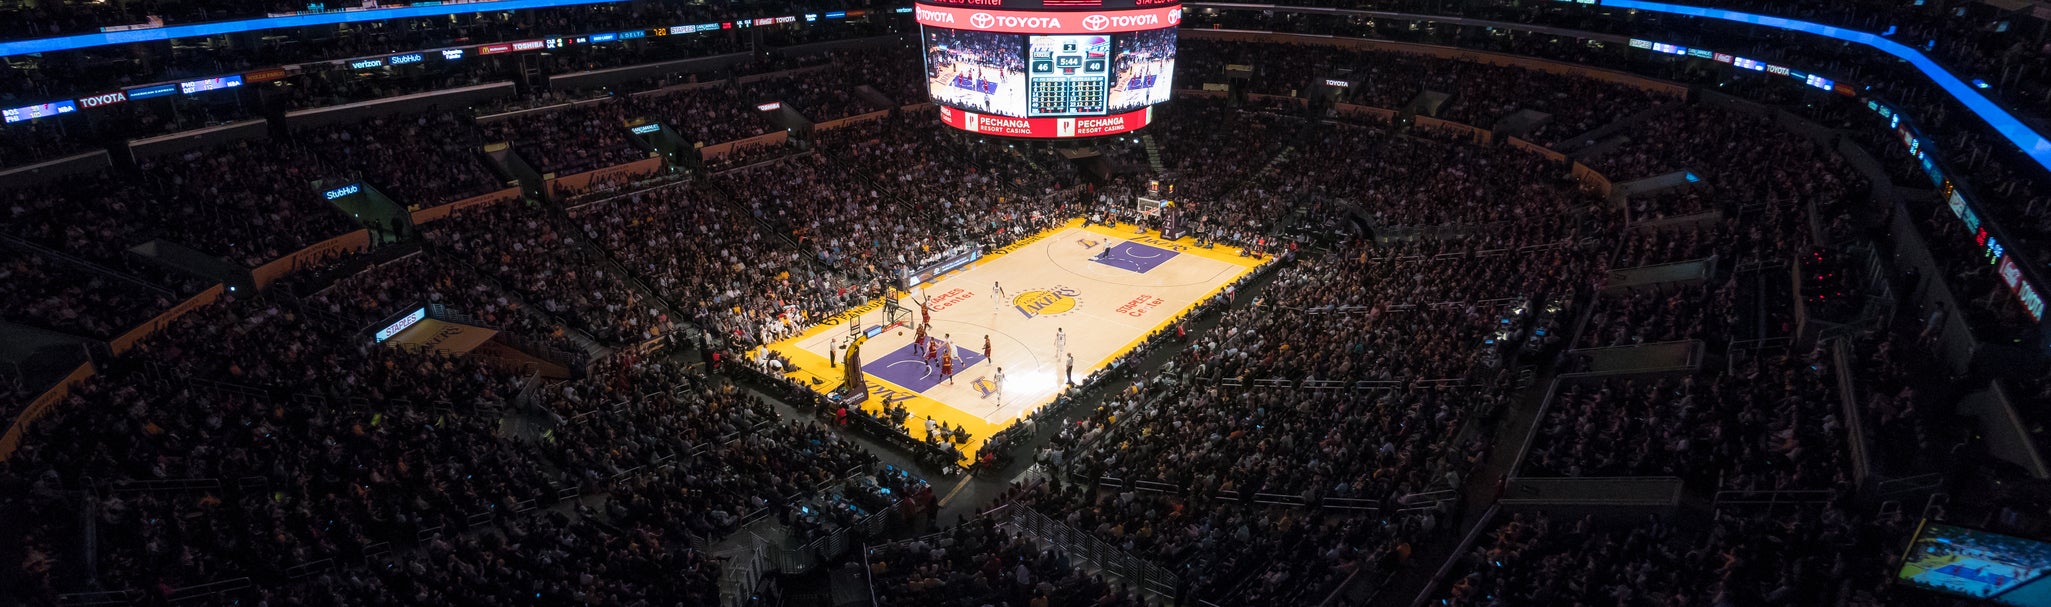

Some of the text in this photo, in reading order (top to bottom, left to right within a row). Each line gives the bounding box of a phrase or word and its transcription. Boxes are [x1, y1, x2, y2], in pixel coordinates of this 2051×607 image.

[921, 10, 954, 23] TOYOTA
[995, 16, 1061, 28] TOYOTA
[1110, 14, 1158, 27] TOYOTA
[671, 25, 695, 34] STAPLES
[513, 41, 544, 50] TOSHIBA
[352, 60, 381, 69] verizon
[392, 54, 421, 64] StubHub
[1060, 58, 1078, 66] 5:44
[1037, 63, 1048, 71] 46
[1766, 64, 1790, 76] TOYOTA
[80, 92, 126, 108] TOYOTA
[980, 117, 1030, 128] PECHANGA
[1078, 117, 1124, 128] PECHANGA
[980, 125, 1003, 133] RESORT
[327, 185, 358, 200] StubHub
[933, 291, 975, 311] Center
[1015, 288, 1081, 319] LAKERS
[1115, 294, 1152, 314] STAPLES
[385, 313, 417, 337] STAPLES
